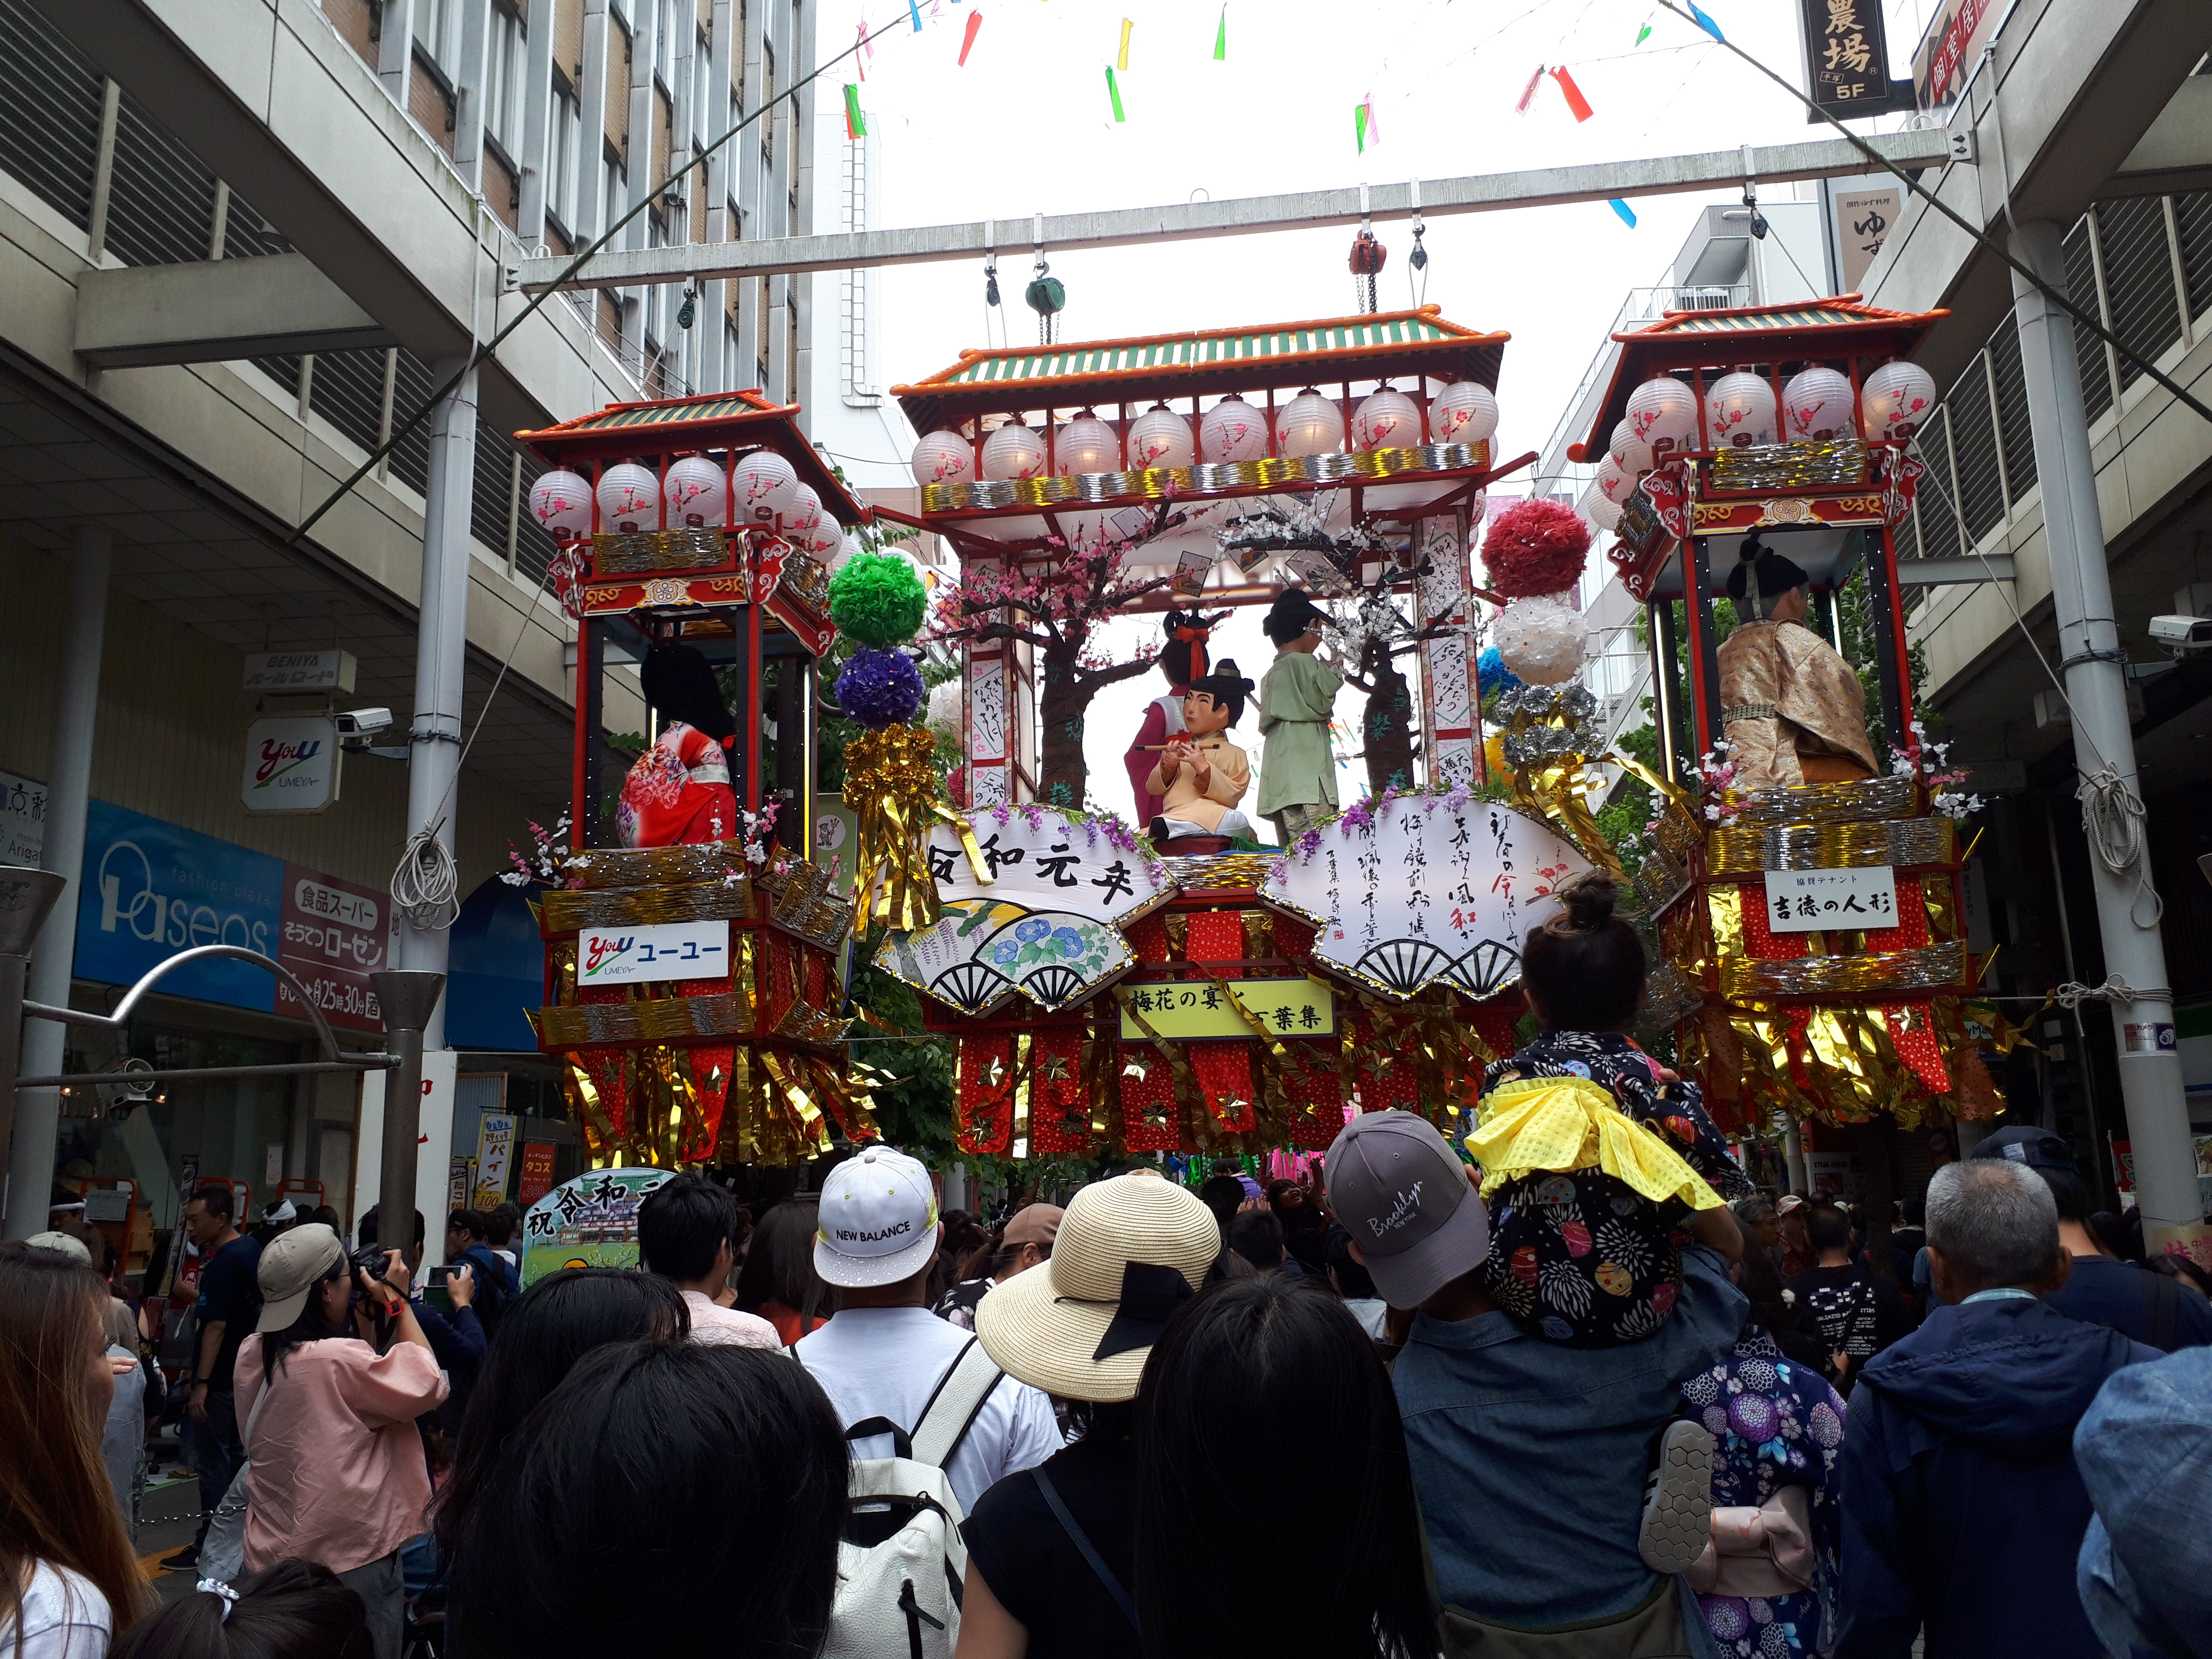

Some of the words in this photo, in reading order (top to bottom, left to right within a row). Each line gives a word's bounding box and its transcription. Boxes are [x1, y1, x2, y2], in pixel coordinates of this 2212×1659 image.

[1823, 0, 1871, 72] 農場
[1837, 83, 1864, 99] 5F
[266, 654, 319, 668] BENIYA
[245, 671, 335, 685] パールロード
[279, 777, 314, 787] UMEYA
[173, 866, 228, 893] fashion
[235, 887, 271, 906] plaza
[99, 841, 268, 957] Paseos
[301, 885, 375, 923] 食品スーパー
[637, 942, 722, 962] ユーユー
[605, 966, 631, 975] UMEYA
[526, 1161, 551, 1173] タコス
[527, 1185, 544, 1199] 500
[478, 1195, 498, 1207] 100
[1366, 1180, 1424, 1238] Brooklyn
[836, 1229, 857, 1242] NEW
[860, 1221, 911, 1242] BALANCE
[1815, 1313, 1841, 1322] UNLIMITED
